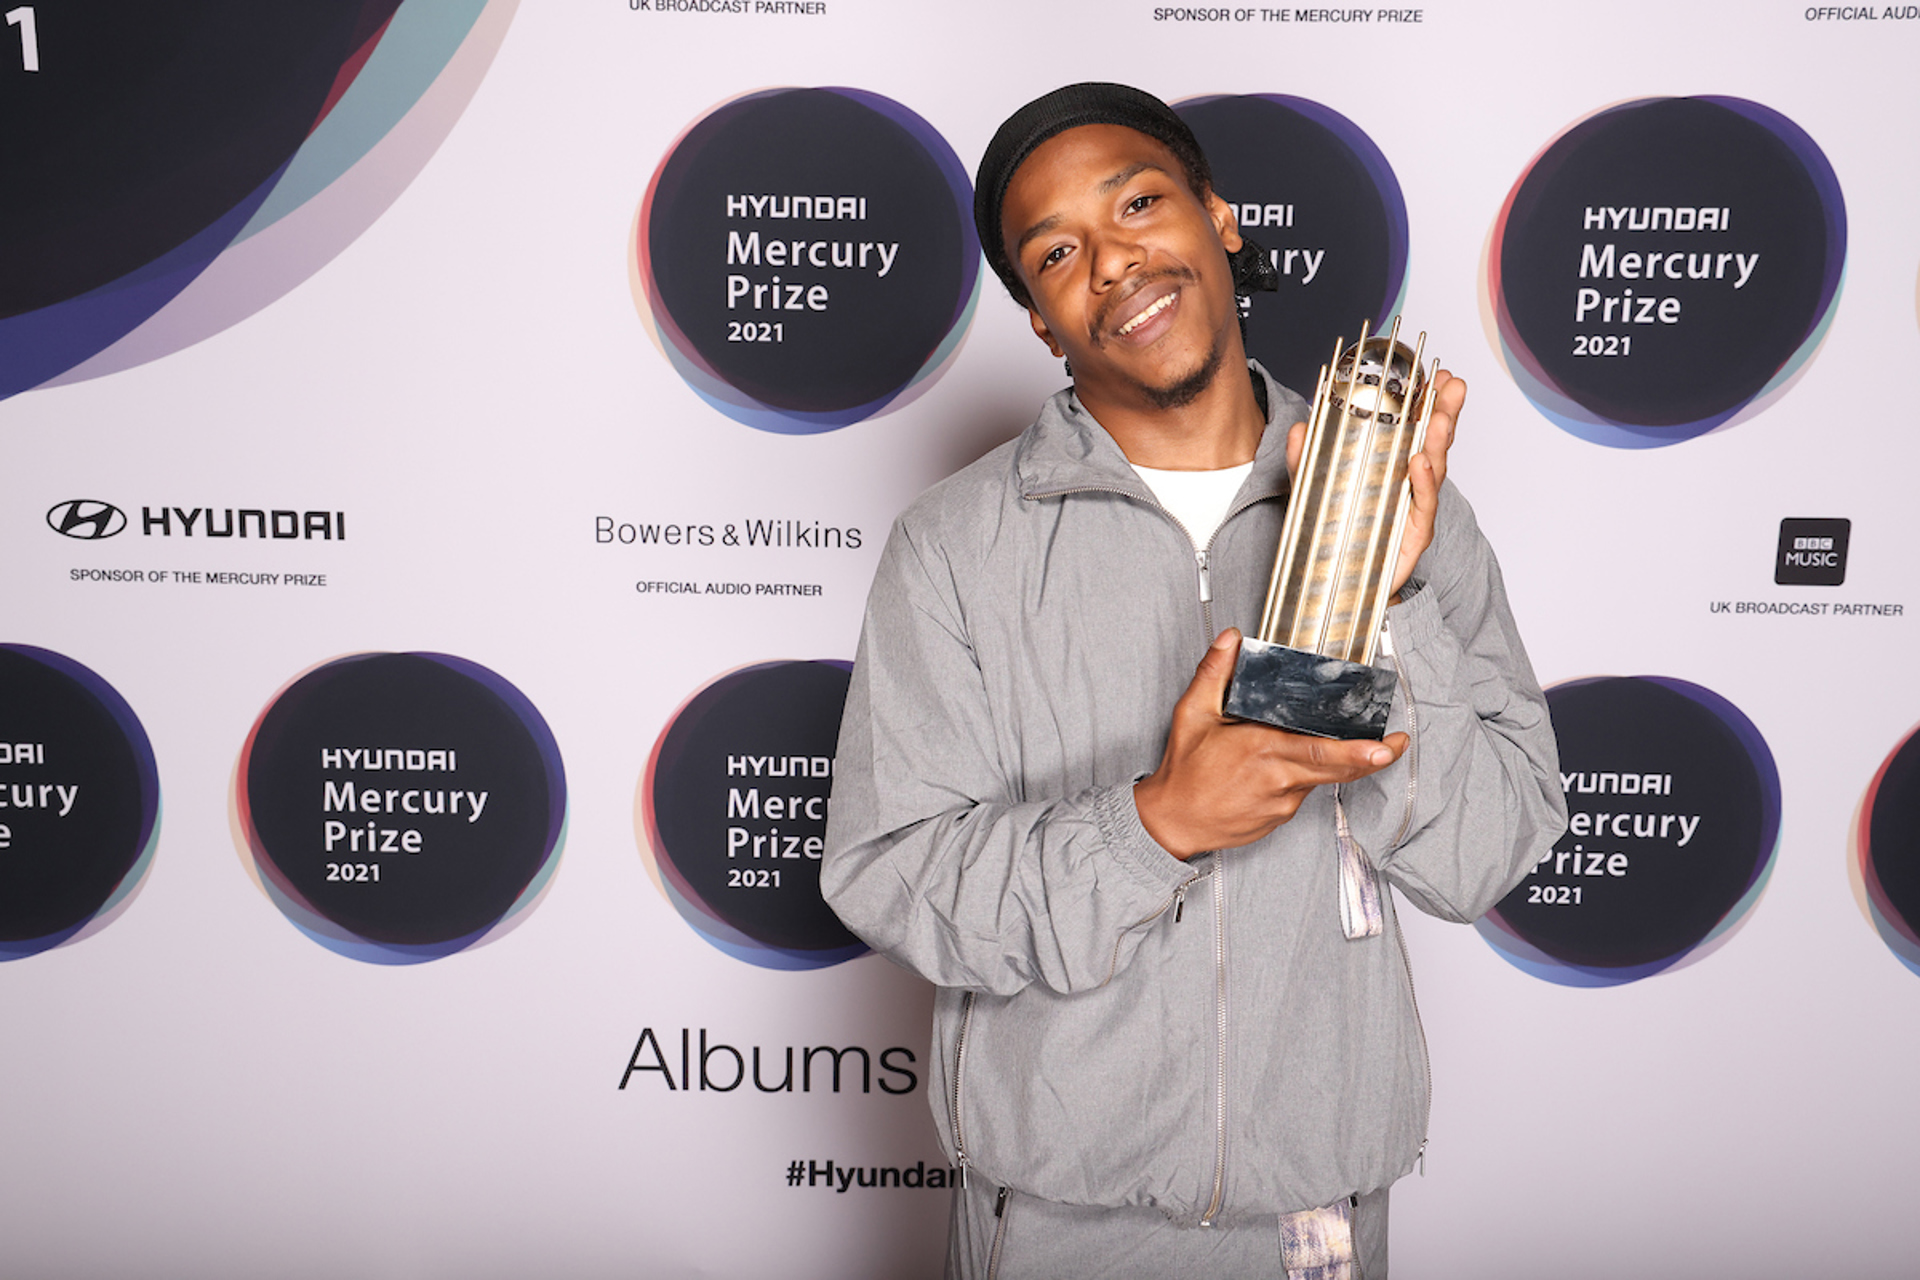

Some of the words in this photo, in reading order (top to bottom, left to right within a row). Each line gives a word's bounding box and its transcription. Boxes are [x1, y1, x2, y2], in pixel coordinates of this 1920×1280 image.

[629, 0, 651, 11] UK
[655, 0, 751, 13] BROADCAST
[755, 1, 827, 15] PARTNER
[1153, 8, 1231, 22] SPONSOR
[1234, 8, 1256, 22] OF
[1260, 9, 1291, 22] THE
[1295, 9, 1374, 23] MERCURY
[1377, 10, 1423, 23] PRIZE
[1804, 6, 1878, 21] OFFICIAL
[1882, 6, 1920, 20] AUD
[727, 194, 866, 220] HYUNDAI
[1583, 206, 1730, 231] HYUNDAI
[727, 232, 899, 277] Mercury
[1578, 243, 1760, 288] Mercury
[727, 275, 829, 311] Prize
[1575, 289, 1681, 324] Prize
[727, 321, 783, 342] 2021
[1572, 336, 1631, 356] 2021
[142, 506, 346, 541] HYUNDAI
[595, 516, 715, 547] Bowers
[745, 519, 862, 549] Wilkins
[1794, 538, 1833, 550] BBC
[1785, 552, 1838, 567] MUSIC
[70, 568, 145, 582] SPONSOR
[148, 570, 169, 583] OF
[173, 571, 202, 584] THE
[206, 572, 280, 585] MERCURY
[283, 573, 327, 587] PRIZE
[636, 581, 702, 595] OFFICIAL
[704, 582, 752, 596] AUDIO
[755, 584, 823, 597] PARTNER
[1709, 601, 1731, 614] UK
[1735, 601, 1830, 616] BROADCAST
[1833, 604, 1904, 617] PARTNER
[321, 748, 456, 772] HYUNDAI
[727, 755, 835, 777] HYUND
[1560, 772, 1672, 795] YUNDAI
[323, 782, 489, 822] Mercury
[727, 788, 831, 820] Merc
[324, 820, 423, 853] Prize
[1569, 811, 1701, 847] ercury
[727, 827, 823, 859] Prize
[326, 863, 380, 882] 2021
[727, 869, 780, 888] 2021
[1527, 886, 1582, 905] 2021
[618, 1027, 918, 1095] Albums
[786, 1160, 964, 1193] #Hyundai
